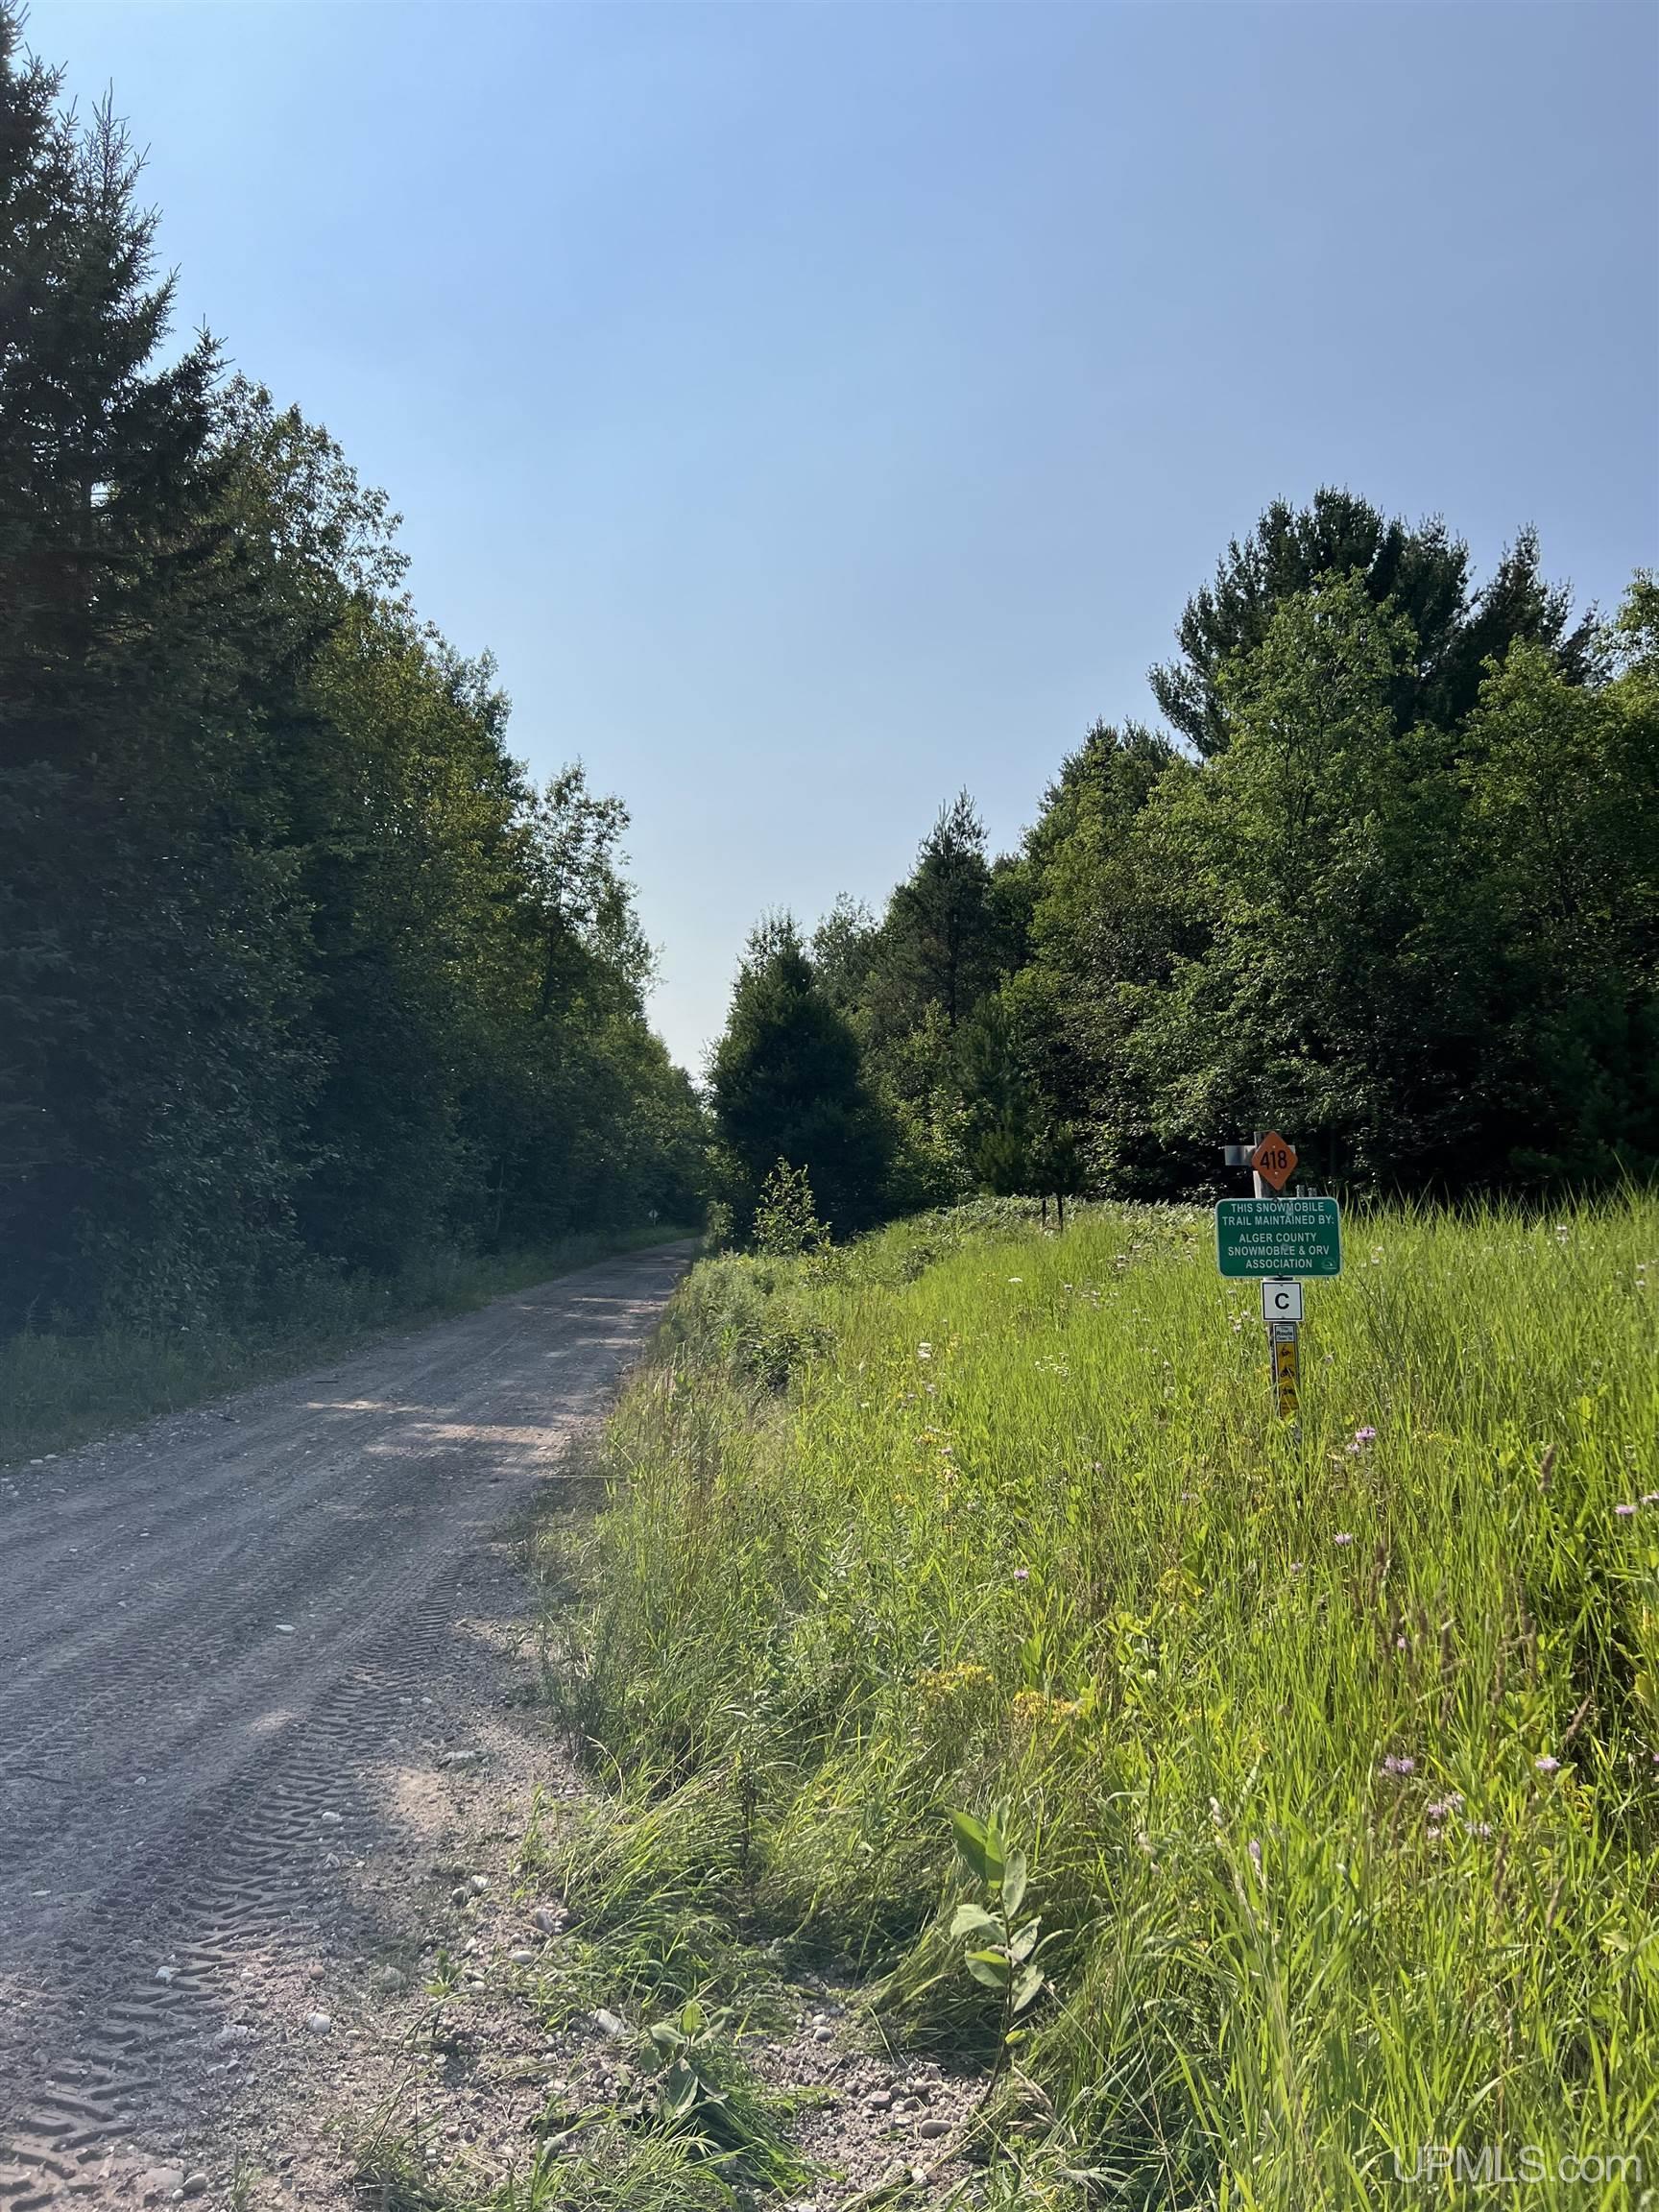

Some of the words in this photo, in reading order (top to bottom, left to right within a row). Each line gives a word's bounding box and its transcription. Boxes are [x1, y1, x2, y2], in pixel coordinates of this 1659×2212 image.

[1260, 1150, 1287, 1169] 418
[1231, 1203, 1254, 1213] THIS
[1256, 1202, 1325, 1213] SNOWMOBILE
[1222, 1216, 1252, 1225] TRAIL
[1255, 1214, 1315, 1225] MAINTAINED
[1318, 1214, 1334, 1225] BY:
[1238, 1233, 1273, 1243] ALGER
[1276, 1233, 1317, 1242] COUNTY
[1228, 1245, 1295, 1256] SNOWMOBILE
[1298, 1245, 1306, 1255] &
[1309, 1245, 1330, 1255] ORV
[1245, 1259, 1312, 1268] ASSOCIATION
[1274, 1292, 1289, 1310] C
